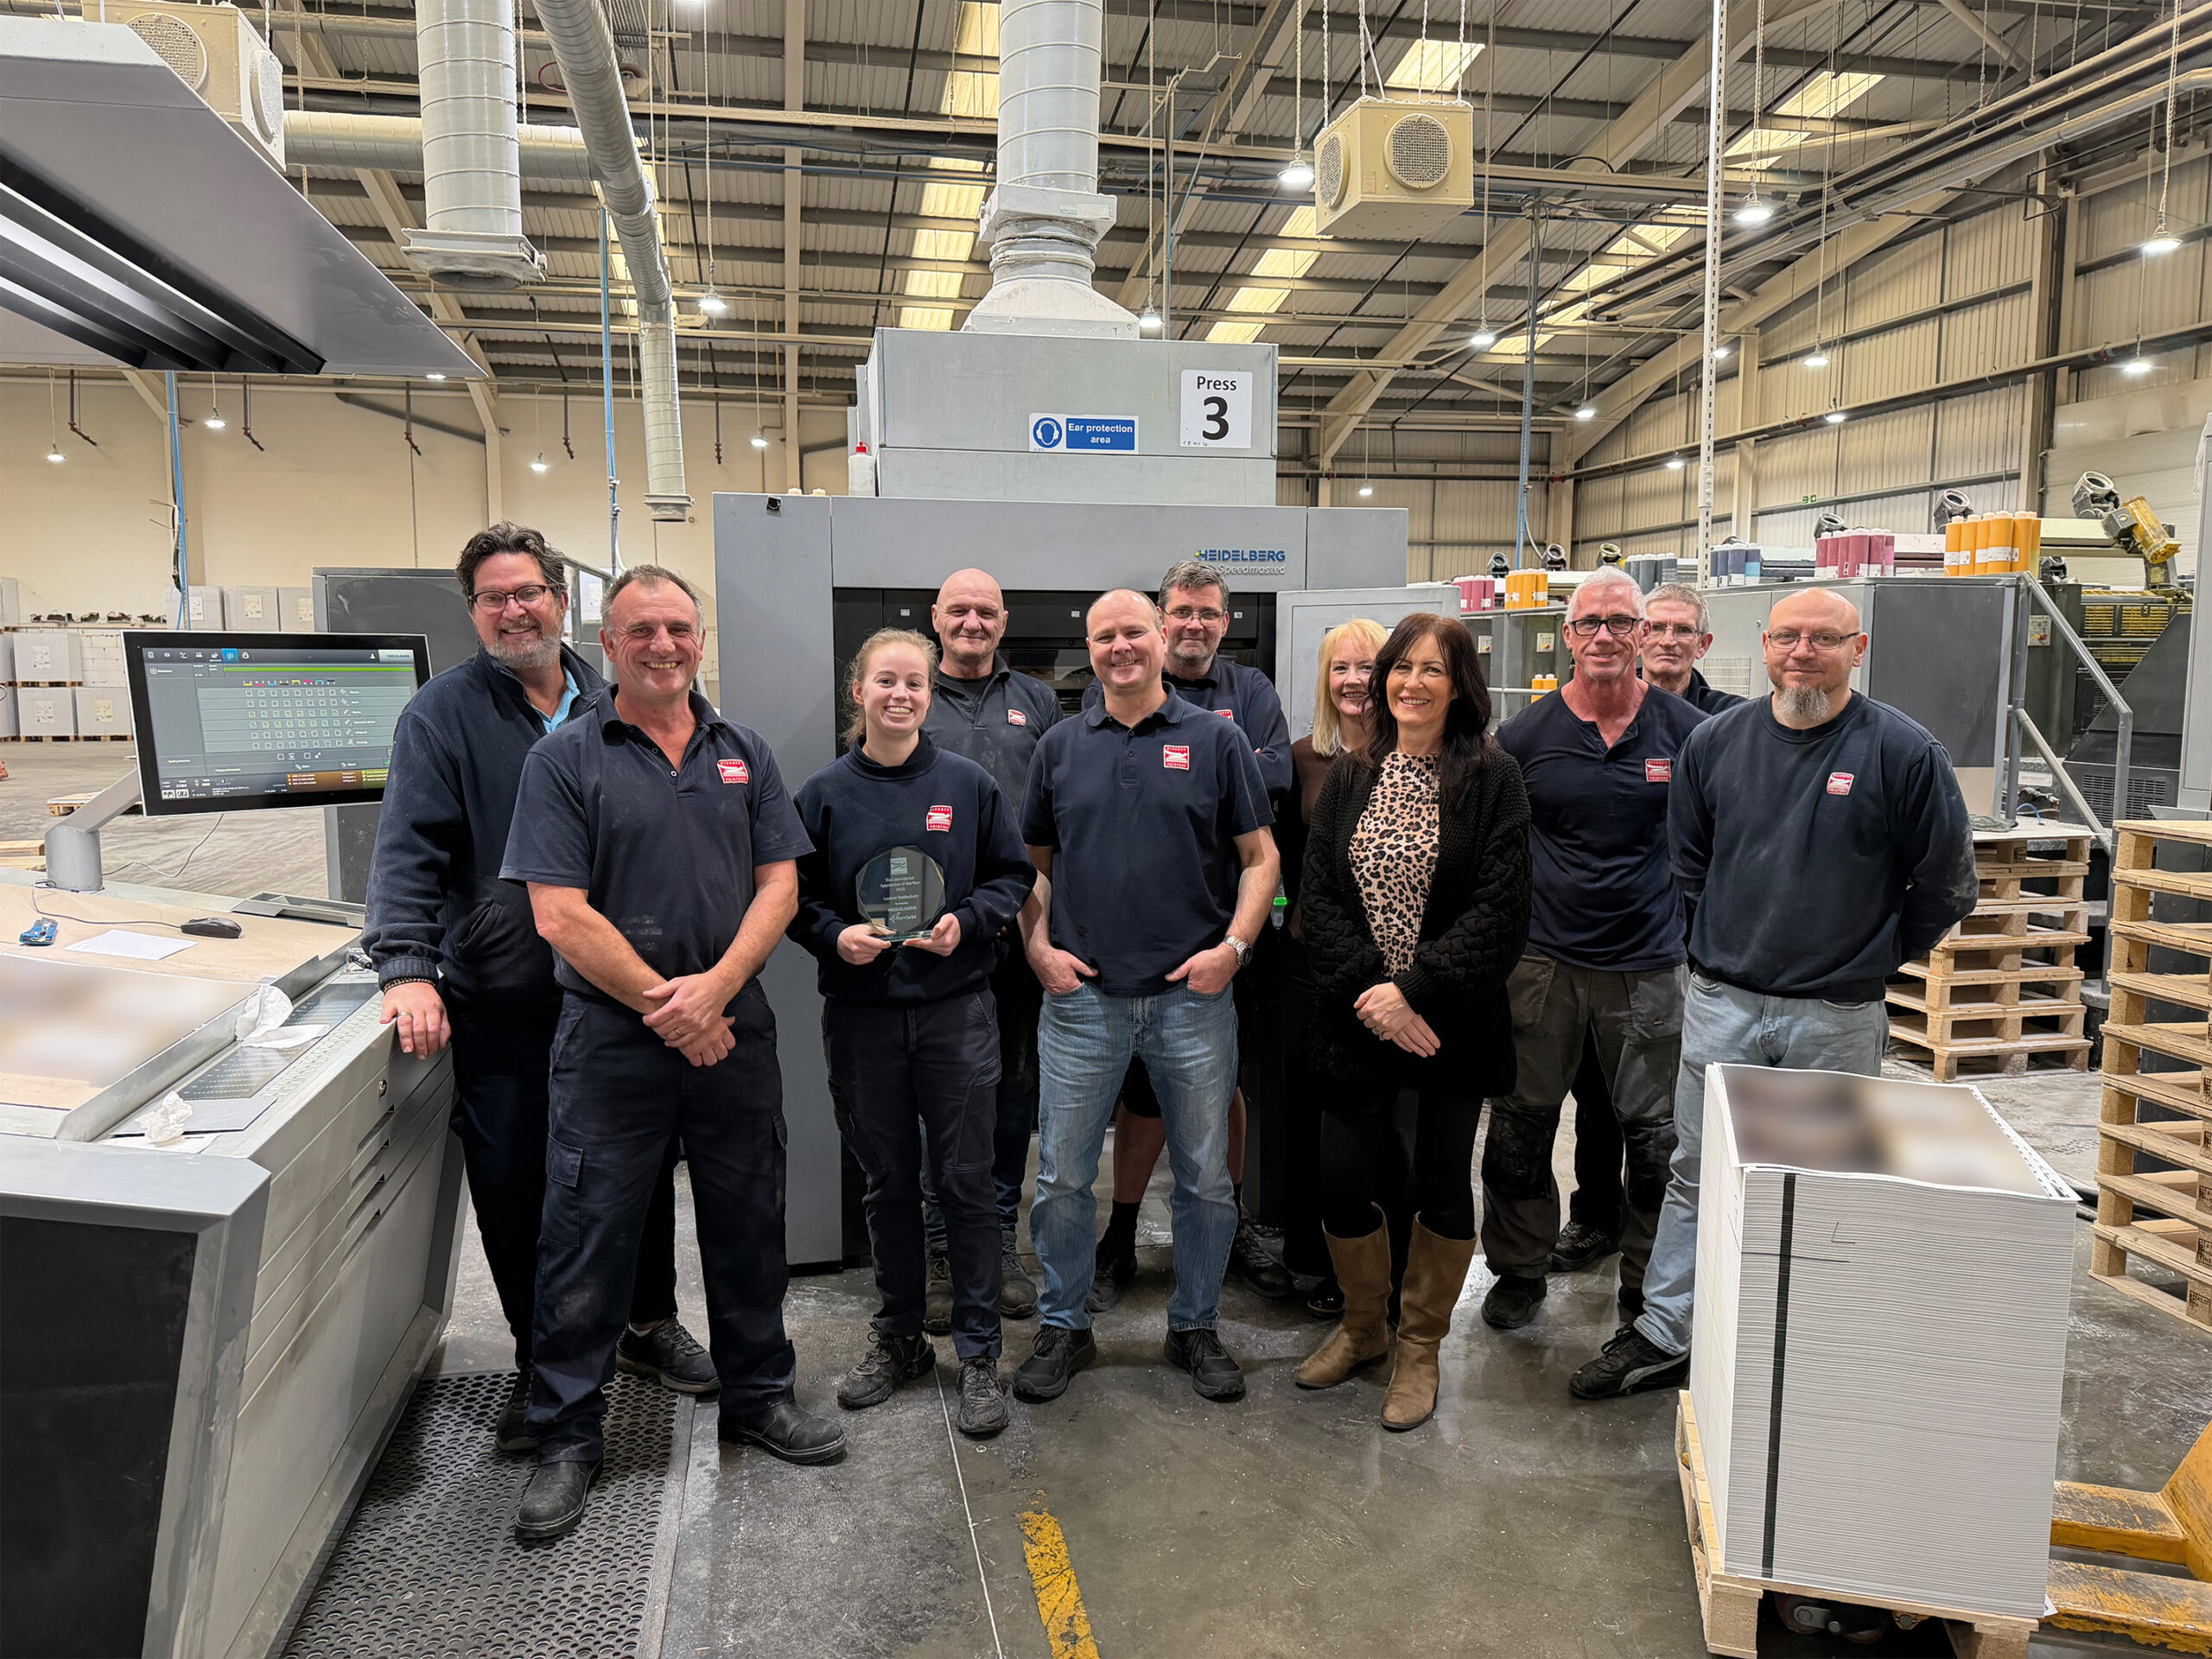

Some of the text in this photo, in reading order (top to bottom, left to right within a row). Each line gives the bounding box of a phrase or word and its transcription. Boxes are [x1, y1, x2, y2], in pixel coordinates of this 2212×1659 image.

[1197, 376, 1237, 391] Press
[1202, 396, 1230, 441] 3
[1068, 423, 1134, 434] Ear protection
[1195, 550, 1287, 562] HEIDELBERG
